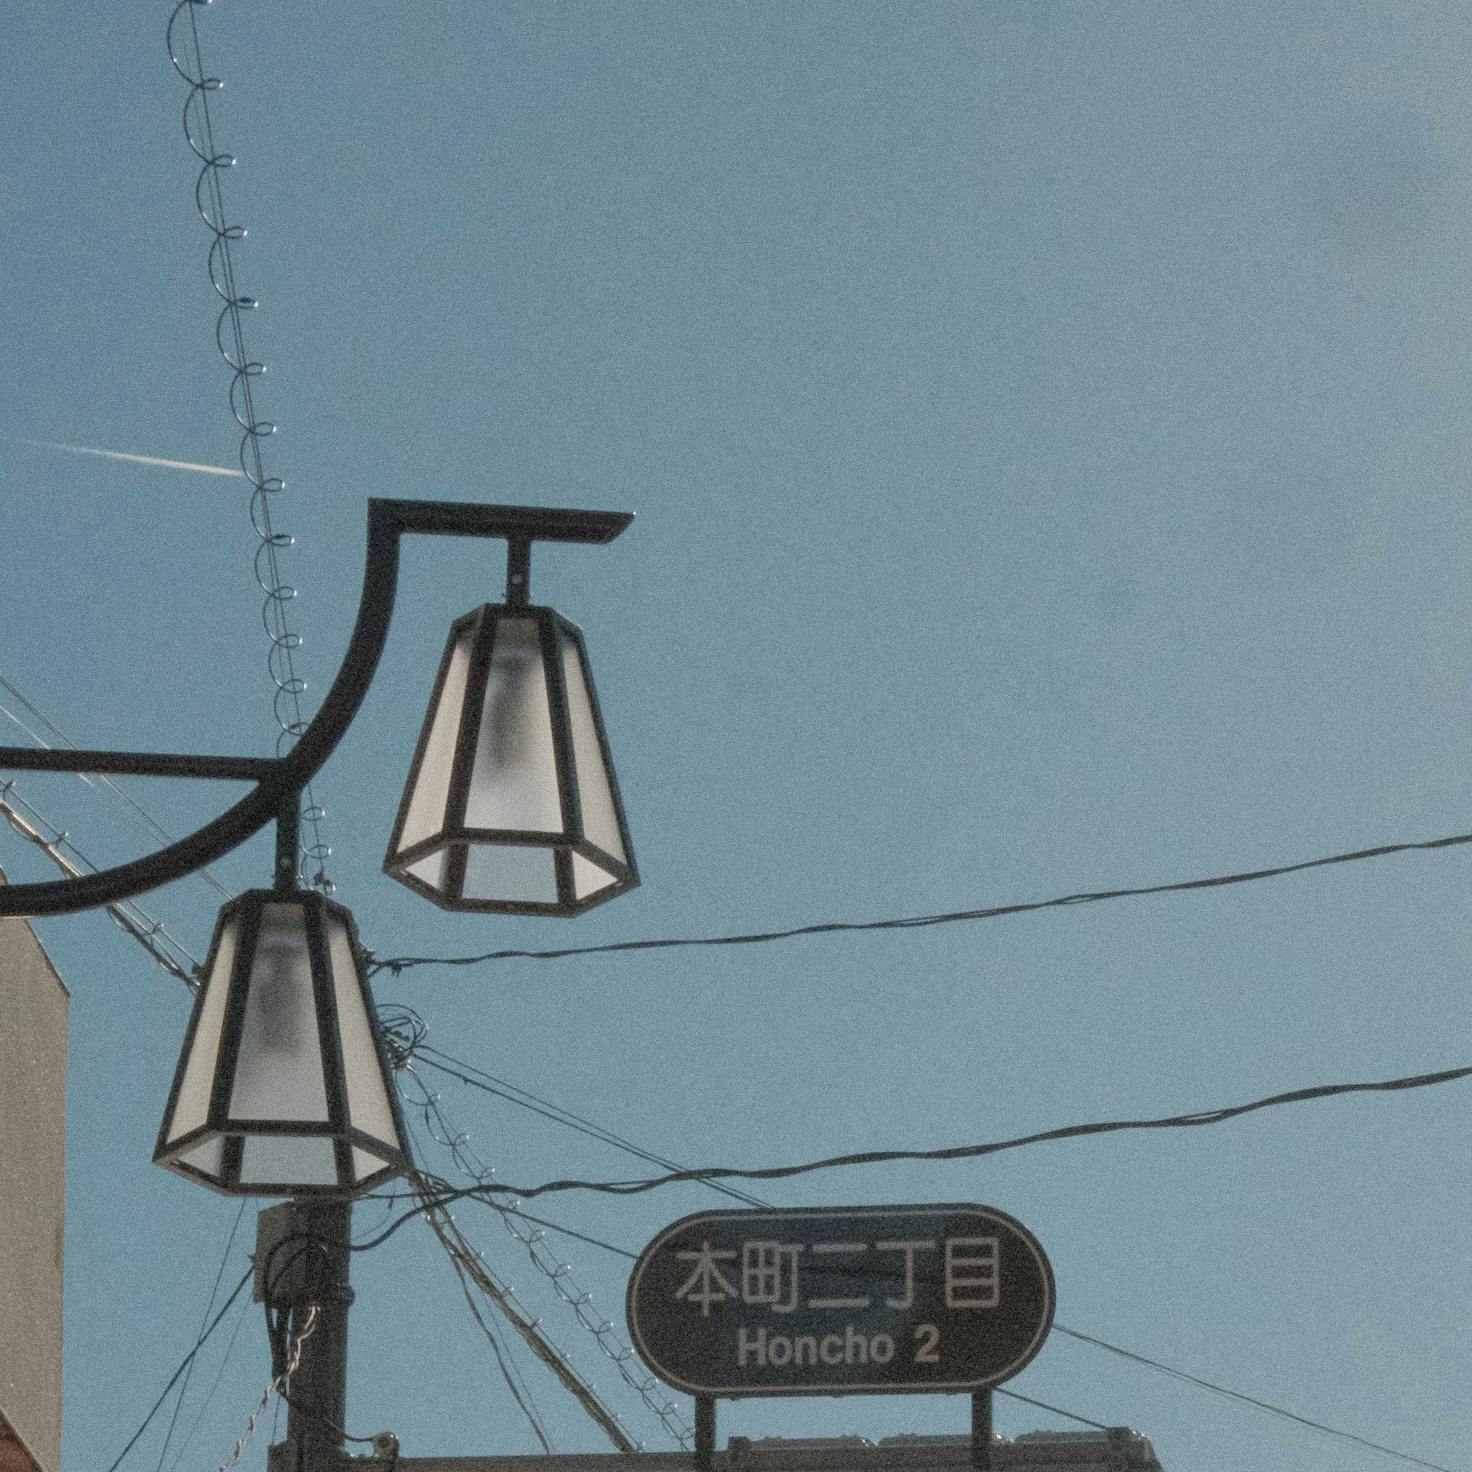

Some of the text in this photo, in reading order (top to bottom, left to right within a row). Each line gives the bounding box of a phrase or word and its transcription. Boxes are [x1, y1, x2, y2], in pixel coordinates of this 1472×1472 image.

[675, 1235, 1001, 1317] 本町二丁目
[737, 1323, 940, 1368] Honcho 2
